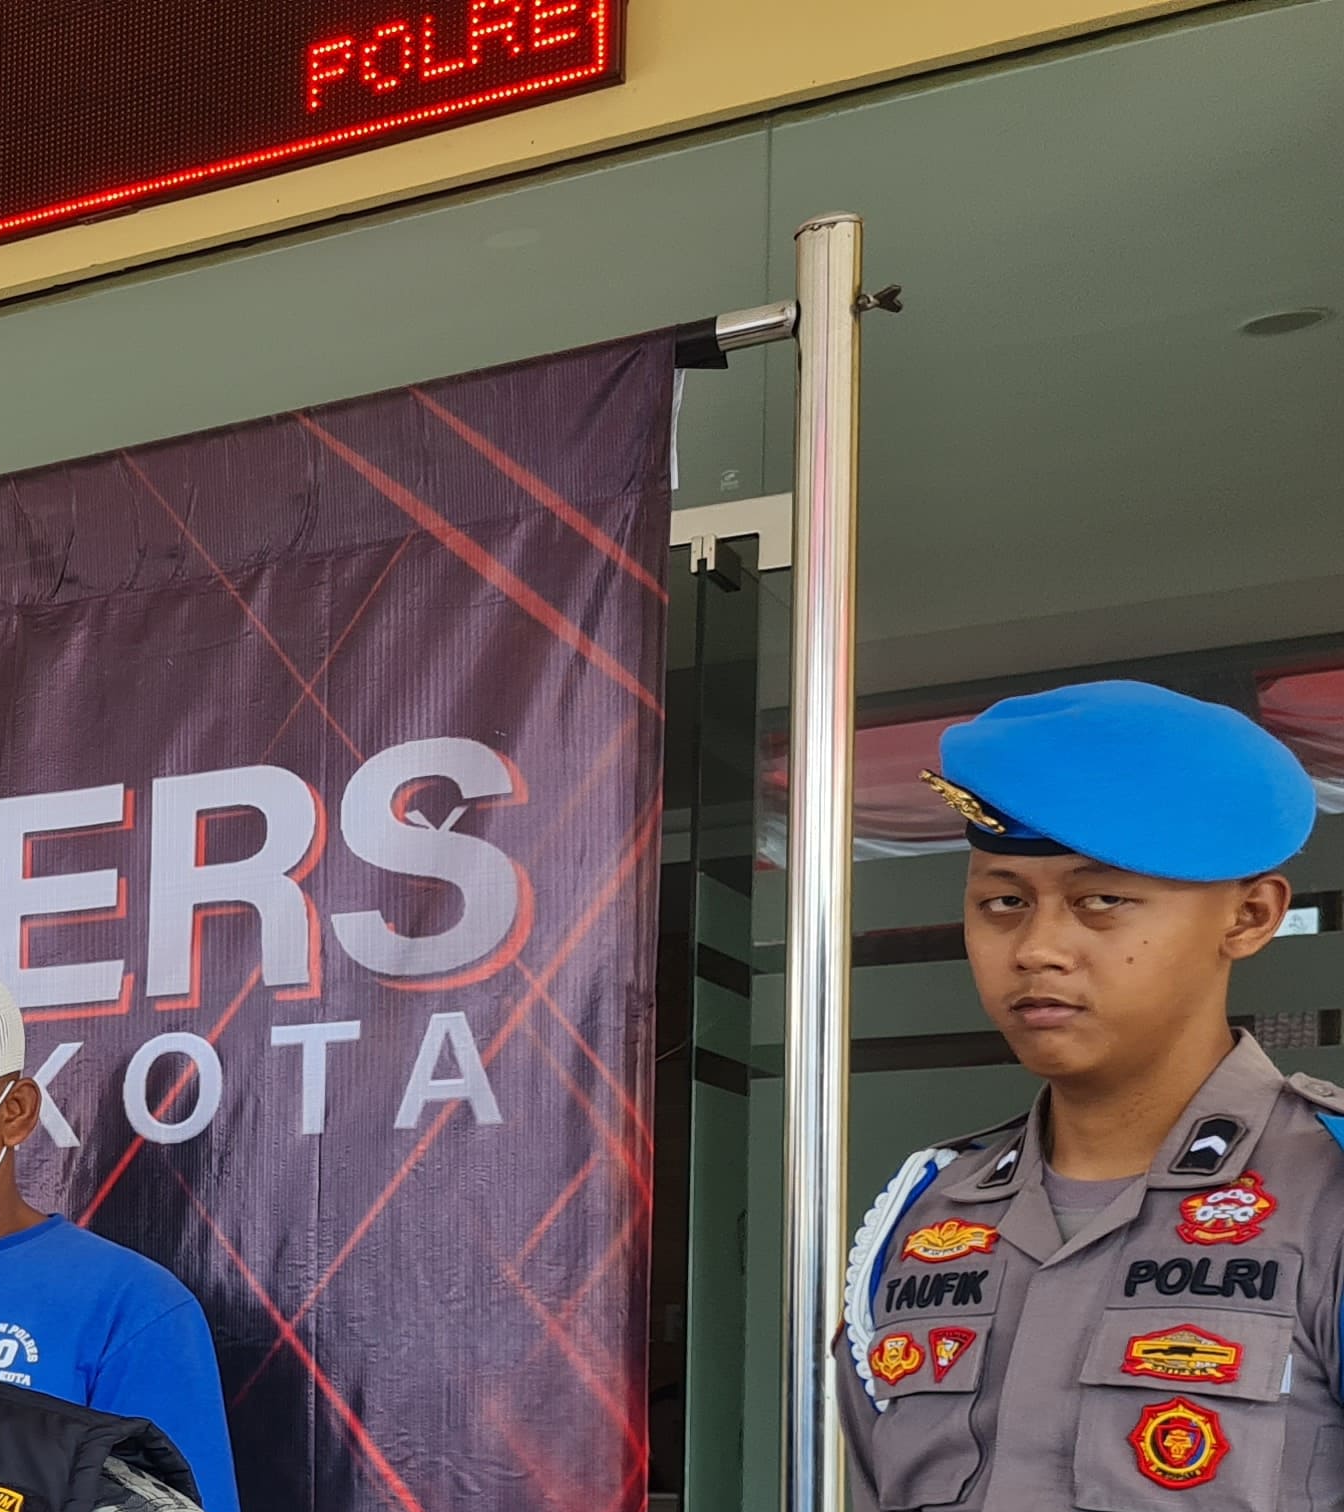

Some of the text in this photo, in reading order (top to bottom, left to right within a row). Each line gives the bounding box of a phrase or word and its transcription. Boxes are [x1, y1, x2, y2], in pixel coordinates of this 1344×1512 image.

[310, 0, 586, 109] POLRE
[4, 1011, 504, 1150] KOTA
[885, 1269, 990, 1313] TAUFIK
[1123, 1256, 1279, 1302] POLRI
[8, 1325, 38, 1363] POLRES
